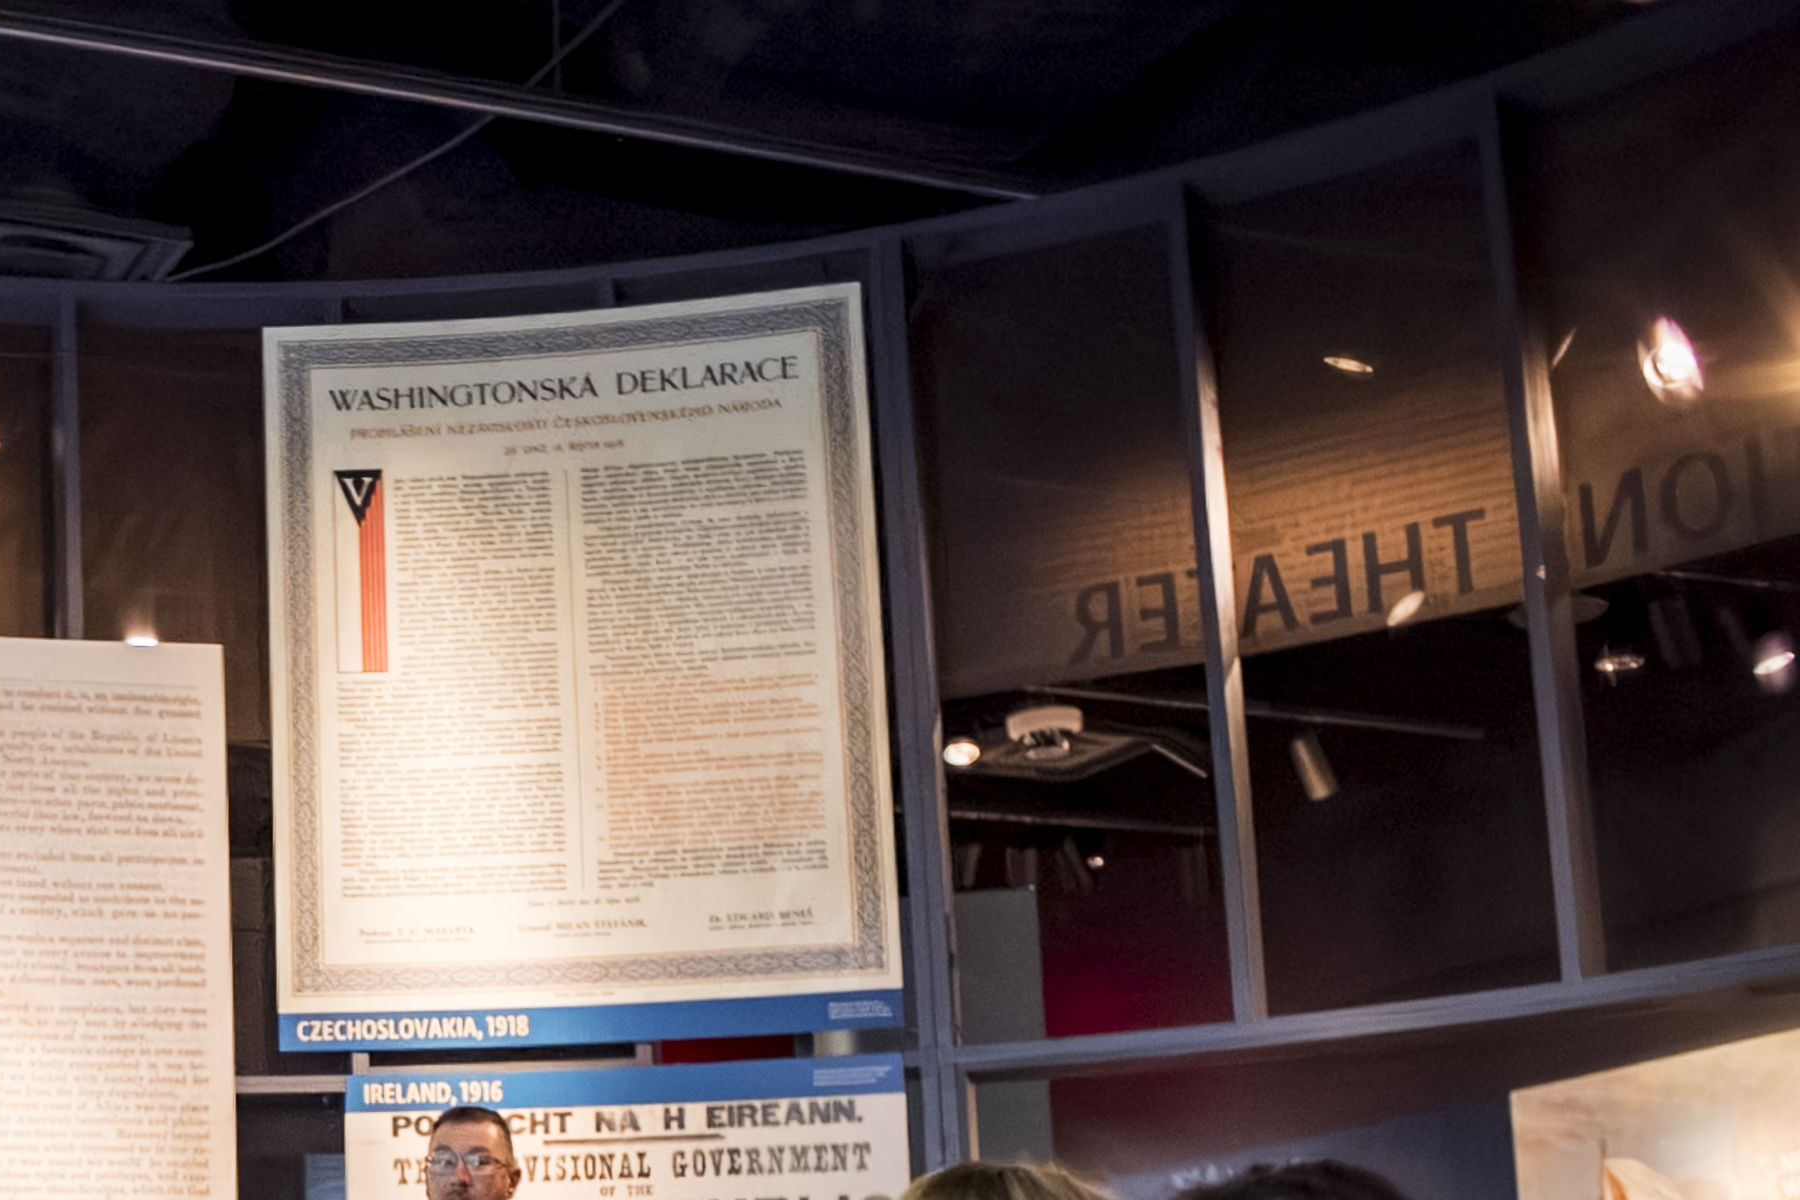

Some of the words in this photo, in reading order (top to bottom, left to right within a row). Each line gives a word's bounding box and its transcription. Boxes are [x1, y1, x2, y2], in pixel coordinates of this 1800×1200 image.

[328, 372, 599, 412] WASHINGTONSKÁ
[615, 355, 800, 396] DEKLARACE
[296, 1015, 484, 1042] CZECHOSLOVAKIA,
[485, 1014, 530, 1038] 1918
[363, 1081, 457, 1107] IRELAND,
[458, 1080, 504, 1104] 1916
[391, 1112, 573, 1138] POCHT
[595, 1109, 642, 1133] NA
[663, 1106, 686, 1131] H
[706, 1099, 864, 1129] EIREANN.
[672, 1142, 873, 1179] GOVERNMENT
[627, 1185, 655, 1197] THE
